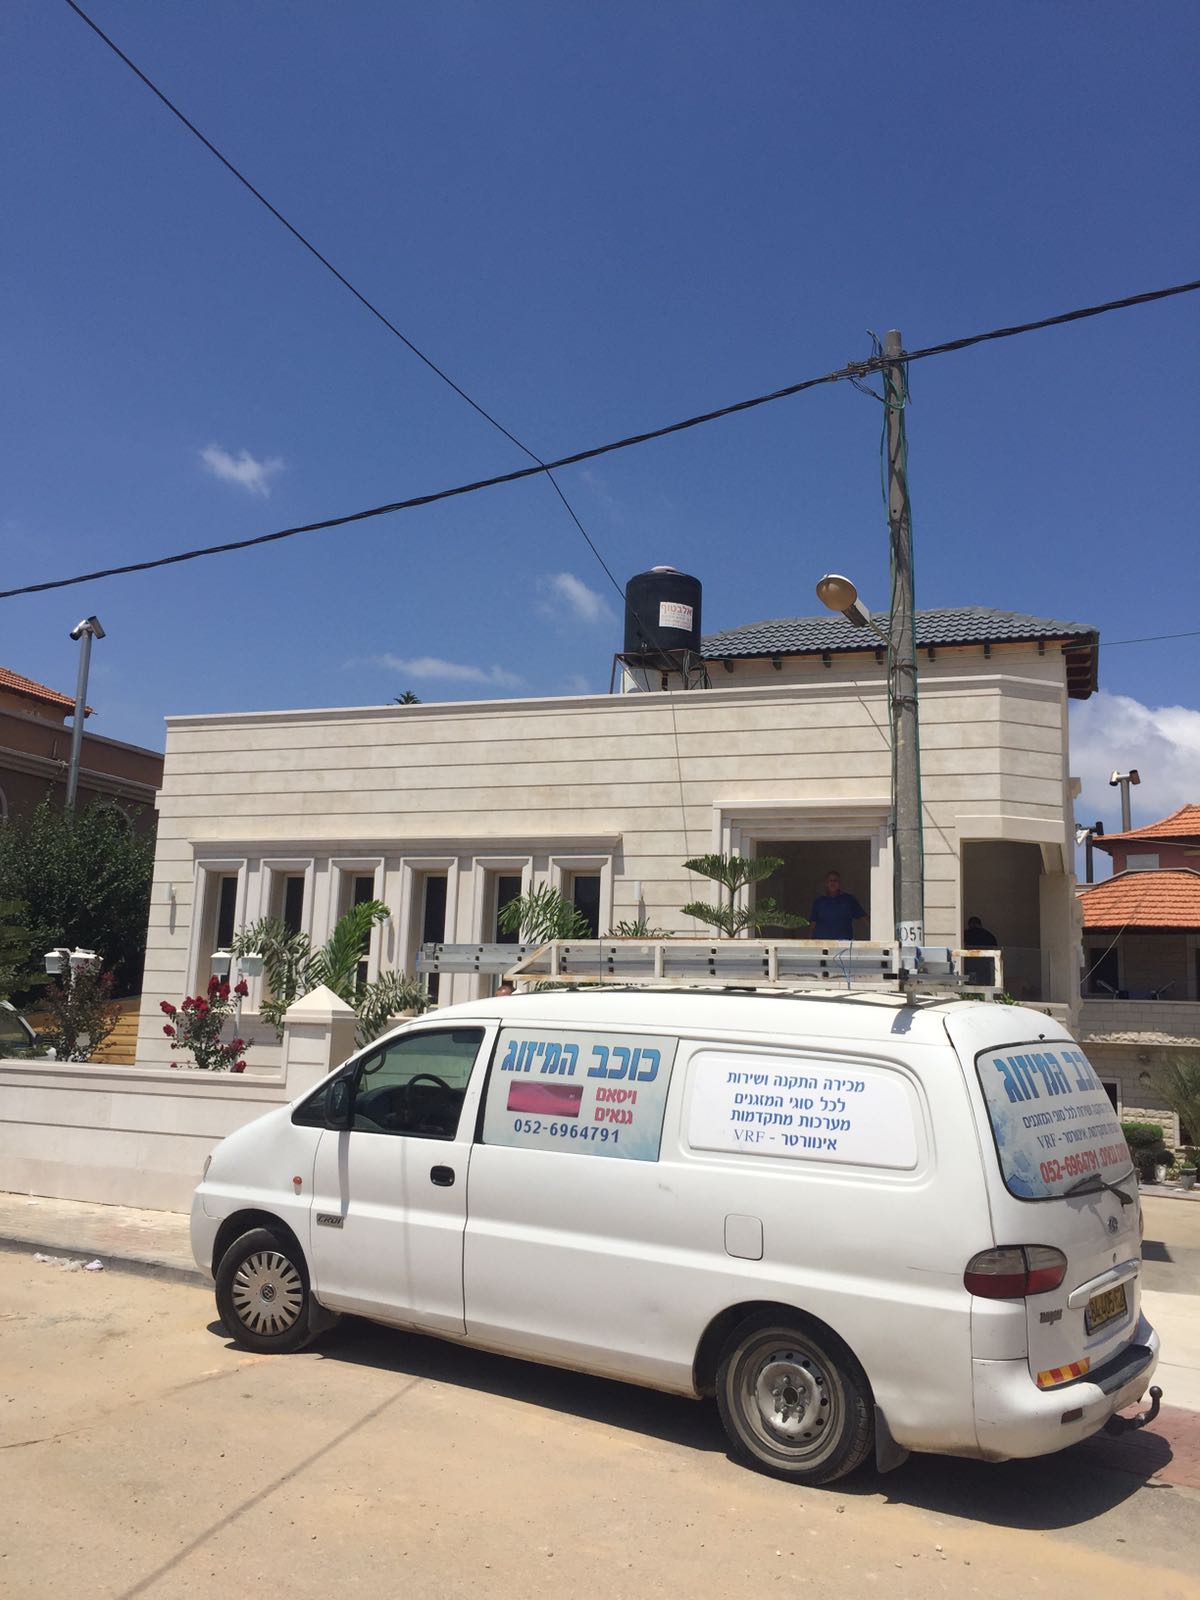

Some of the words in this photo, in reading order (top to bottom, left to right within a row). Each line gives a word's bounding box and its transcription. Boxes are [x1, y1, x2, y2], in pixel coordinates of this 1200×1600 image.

[500, 1039, 580, 1076] המיזוג
[587, 1044, 661, 1082] כוכב
[726, 1071, 768, 1086] ושירות
[773, 1074, 818, 1090] התקנה
[823, 1077, 865, 1093] מכירה
[992, 1052, 1072, 1103] המיזוג
[595, 1087, 638, 1105] ויסאם
[734, 1091, 784, 1107] המזגנים
[788, 1095, 814, 1110] סוגי
[820, 1095, 846, 1113] לכל
[594, 1106, 634, 1125] גנאים
[730, 1109, 794, 1127] מתקדמות
[797, 1114, 851, 1132] מערכות
[513, 1118, 620, 1143] 052-6964791
[732, 1128, 765, 1143] VRF
[781, 1132, 837, 1151] אינוורטר
[1036, 1132, 1056, 1149] VRF
[1039, 1149, 1100, 1184] 052-6964791
